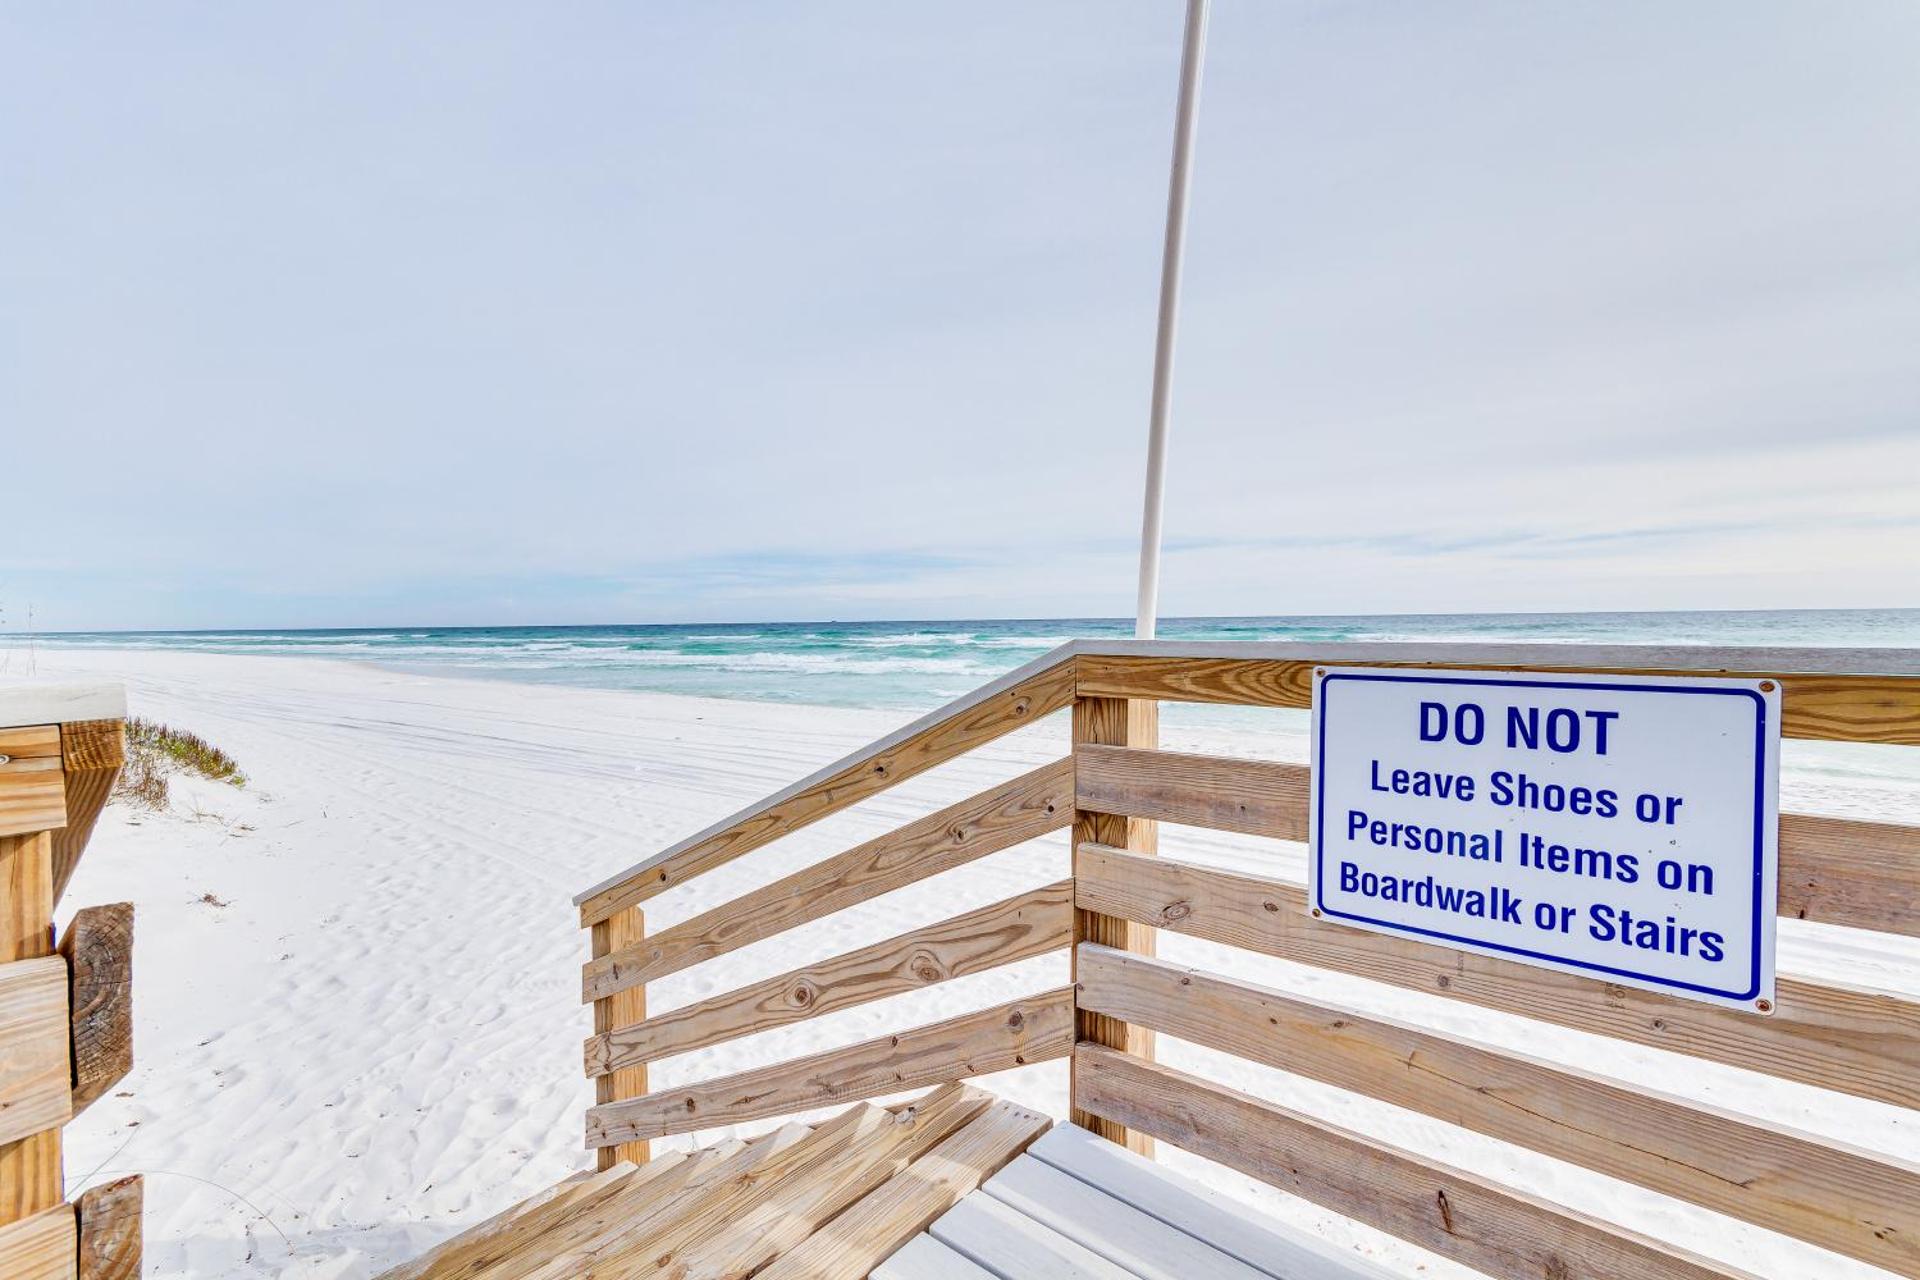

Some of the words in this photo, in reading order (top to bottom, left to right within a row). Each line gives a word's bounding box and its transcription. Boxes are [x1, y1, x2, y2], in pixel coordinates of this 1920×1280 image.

[1419, 701, 1485, 746] DO
[1506, 706, 1619, 756] NOT
[1371, 759, 1475, 802] Leave
[1490, 771, 1619, 819] Shoes
[1635, 793, 1683, 825] or
[1348, 809, 1503, 864] Personal
[1519, 832, 1639, 884] Items
[1657, 859, 1714, 896] on
[1340, 861, 1521, 925] Boardwalk
[1534, 902, 1577, 934] or
[1589, 903, 1724, 962] Stairs
